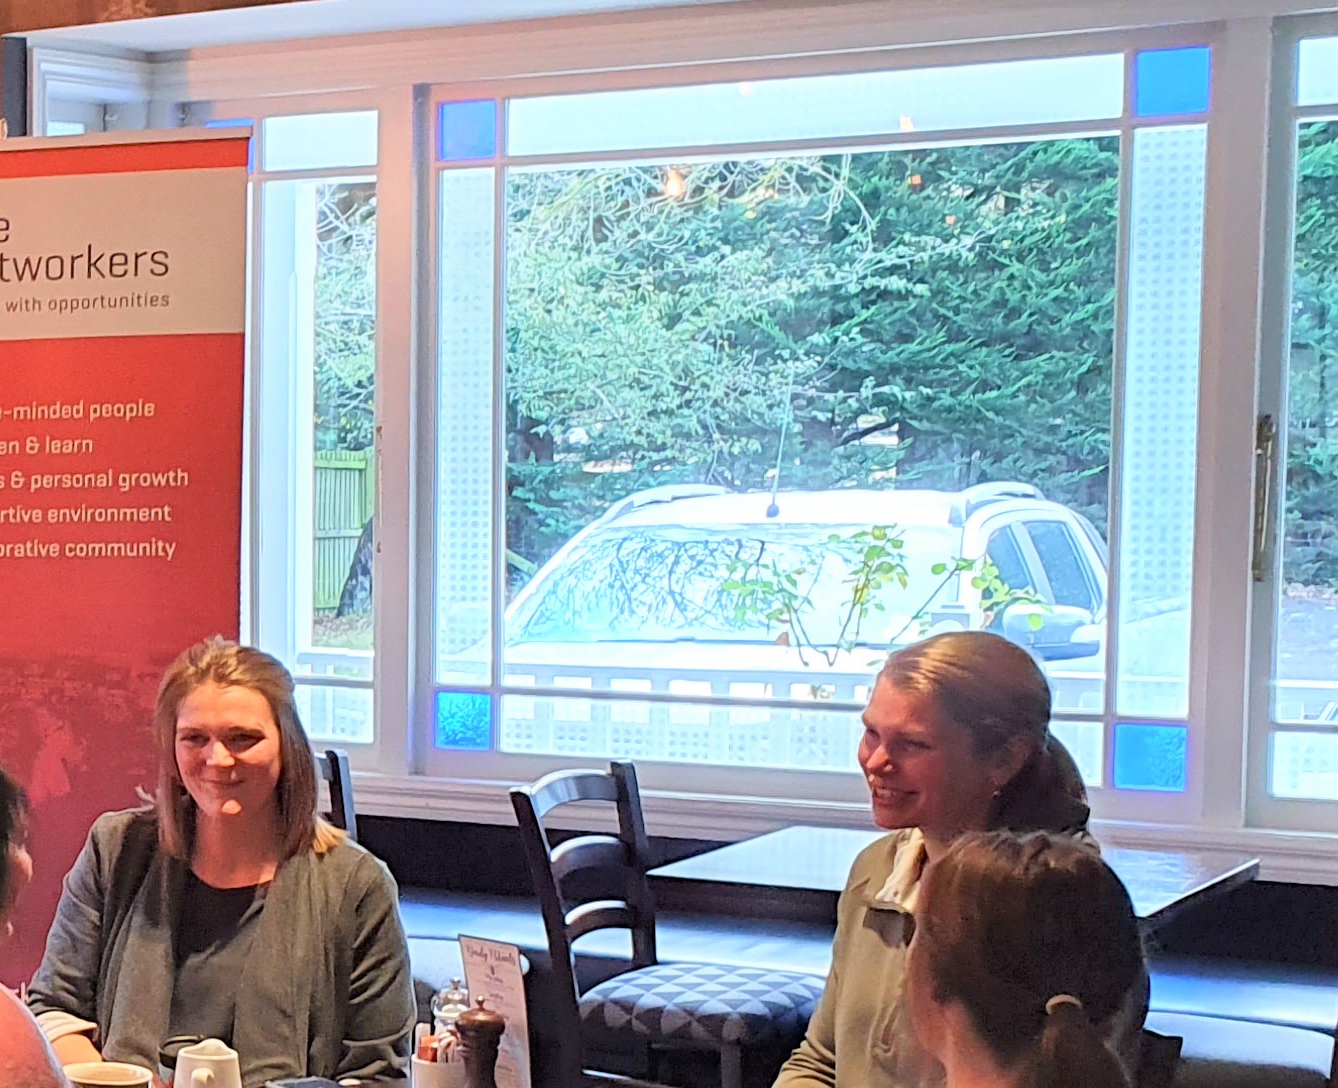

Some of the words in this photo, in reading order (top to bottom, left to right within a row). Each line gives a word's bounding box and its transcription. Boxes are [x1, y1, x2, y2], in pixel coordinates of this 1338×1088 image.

[5, 296, 42, 313] with
[48, 291, 170, 315] opportunities
[89, 399, 155, 422] people
[26, 436, 39, 454] &
[46, 435, 93, 454] learn
[10, 470, 25, 489] &
[30, 468, 113, 492] personal
[118, 468, 189, 491] growth
[47, 503, 172, 523] environment
[64, 539, 176, 561] community
